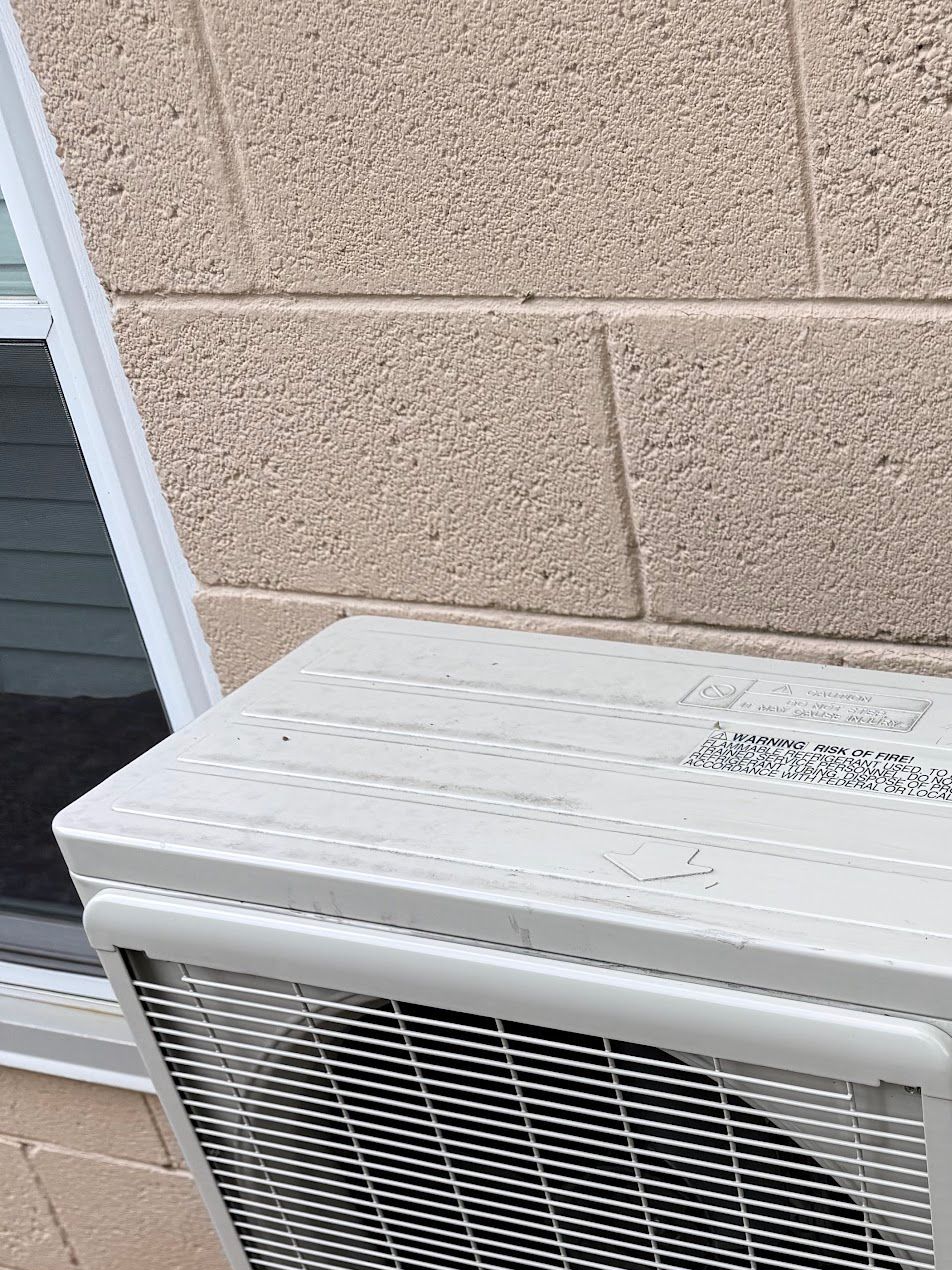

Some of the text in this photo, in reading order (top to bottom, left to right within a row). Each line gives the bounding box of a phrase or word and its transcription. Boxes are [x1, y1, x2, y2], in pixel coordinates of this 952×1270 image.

[699, 746, 755, 761] TRAINED
[756, 754, 815, 767] SERVICE
[907, 773, 929, 782] DO
[702, 739, 785, 755] FLAMMABLE
[784, 750, 882, 768] REFRIGERANT
[929, 768, 948, 777] TO
[733, 733, 915, 764] WARNING RISK OF FIRE!
[683, 759, 779, 777] ACCORDANCE
[781, 771, 819, 783] WITH
[817, 777, 880, 792] FEDERAL
[884, 785, 906, 795] OR
[908, 789, 952, 801] LOCAL
[689, 752, 783, 769] REFRIGERANT
[843, 772, 907, 787] DISPOSE
[908, 780, 929, 790] OF
